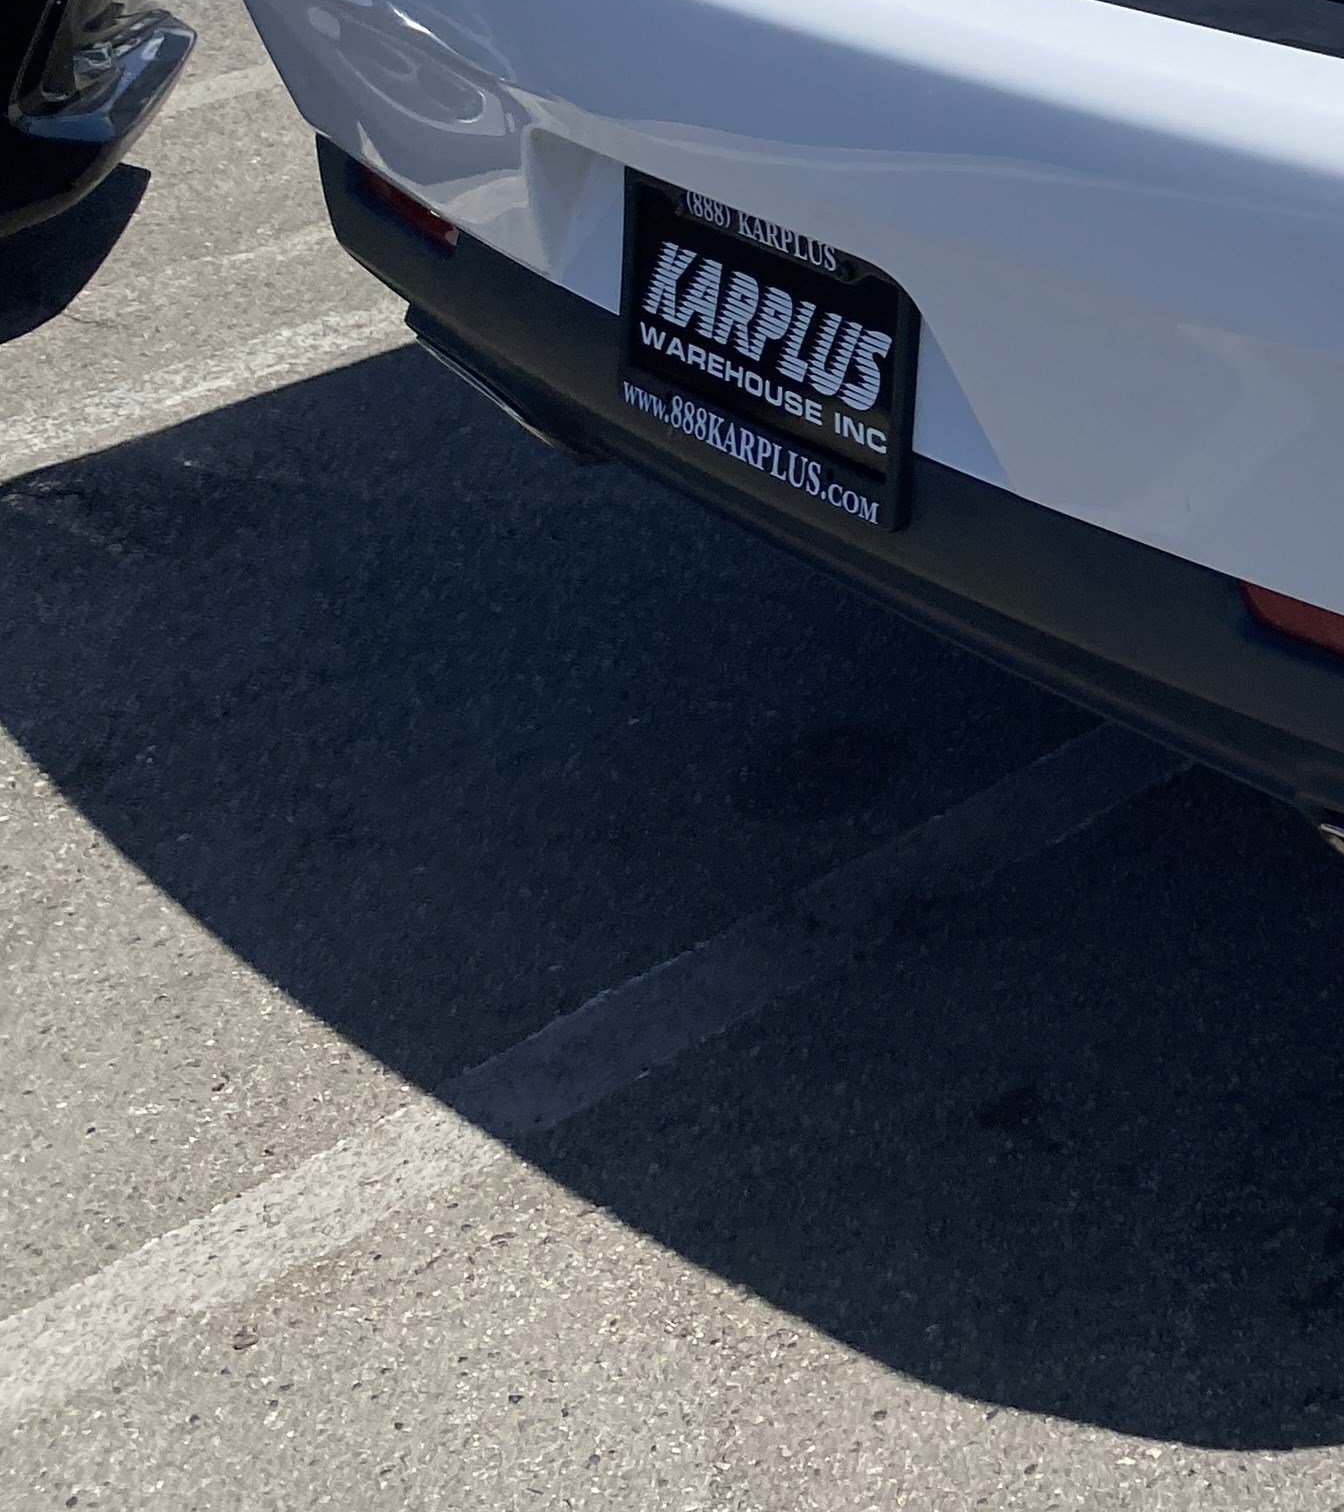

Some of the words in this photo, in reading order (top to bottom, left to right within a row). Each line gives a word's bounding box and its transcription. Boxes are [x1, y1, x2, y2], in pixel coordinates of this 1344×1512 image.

[685, 189, 731, 229] (888)
[737, 208, 838, 272] KARPLUS
[639, 320, 824, 427] WAREHOUSE
[833, 410, 888, 455] INC
[641, 240, 893, 411] KARPLUS
[623, 380, 879, 526] www.888KARPLUS.COM
